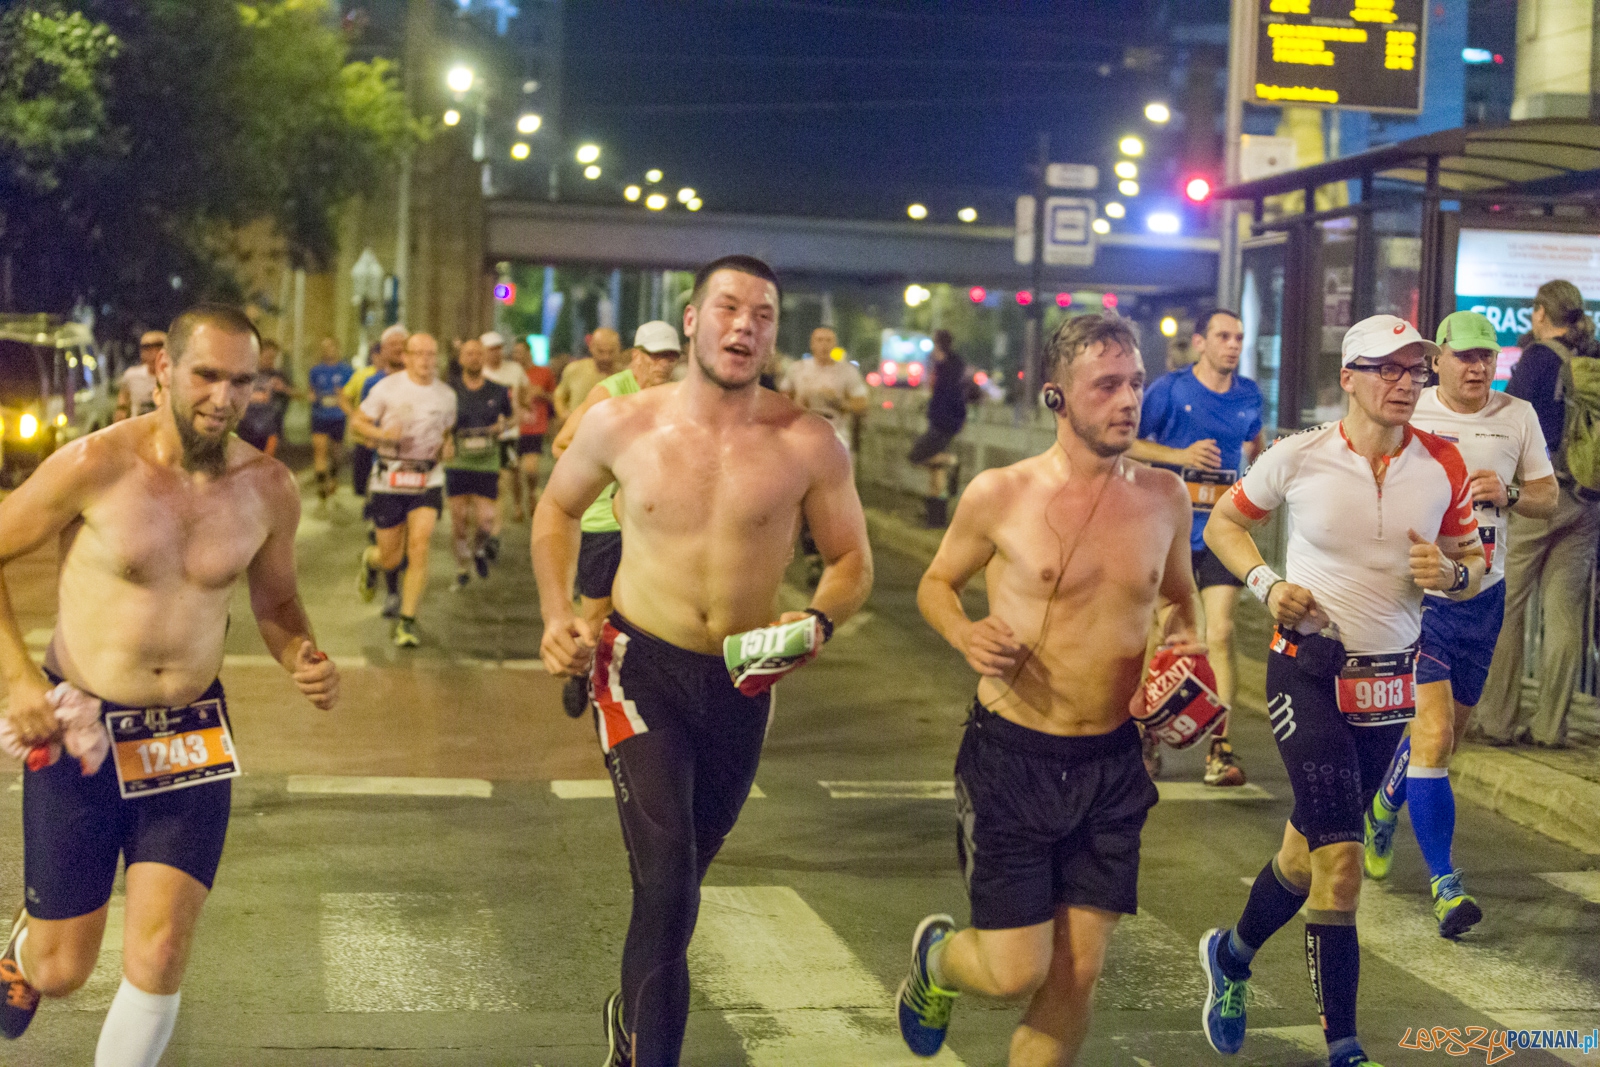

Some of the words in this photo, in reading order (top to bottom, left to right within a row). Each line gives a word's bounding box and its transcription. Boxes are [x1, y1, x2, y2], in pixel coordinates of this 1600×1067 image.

[740, 625, 788, 660] 1511
[1355, 678, 1404, 709] 9813
[136, 733, 209, 775] 1243
